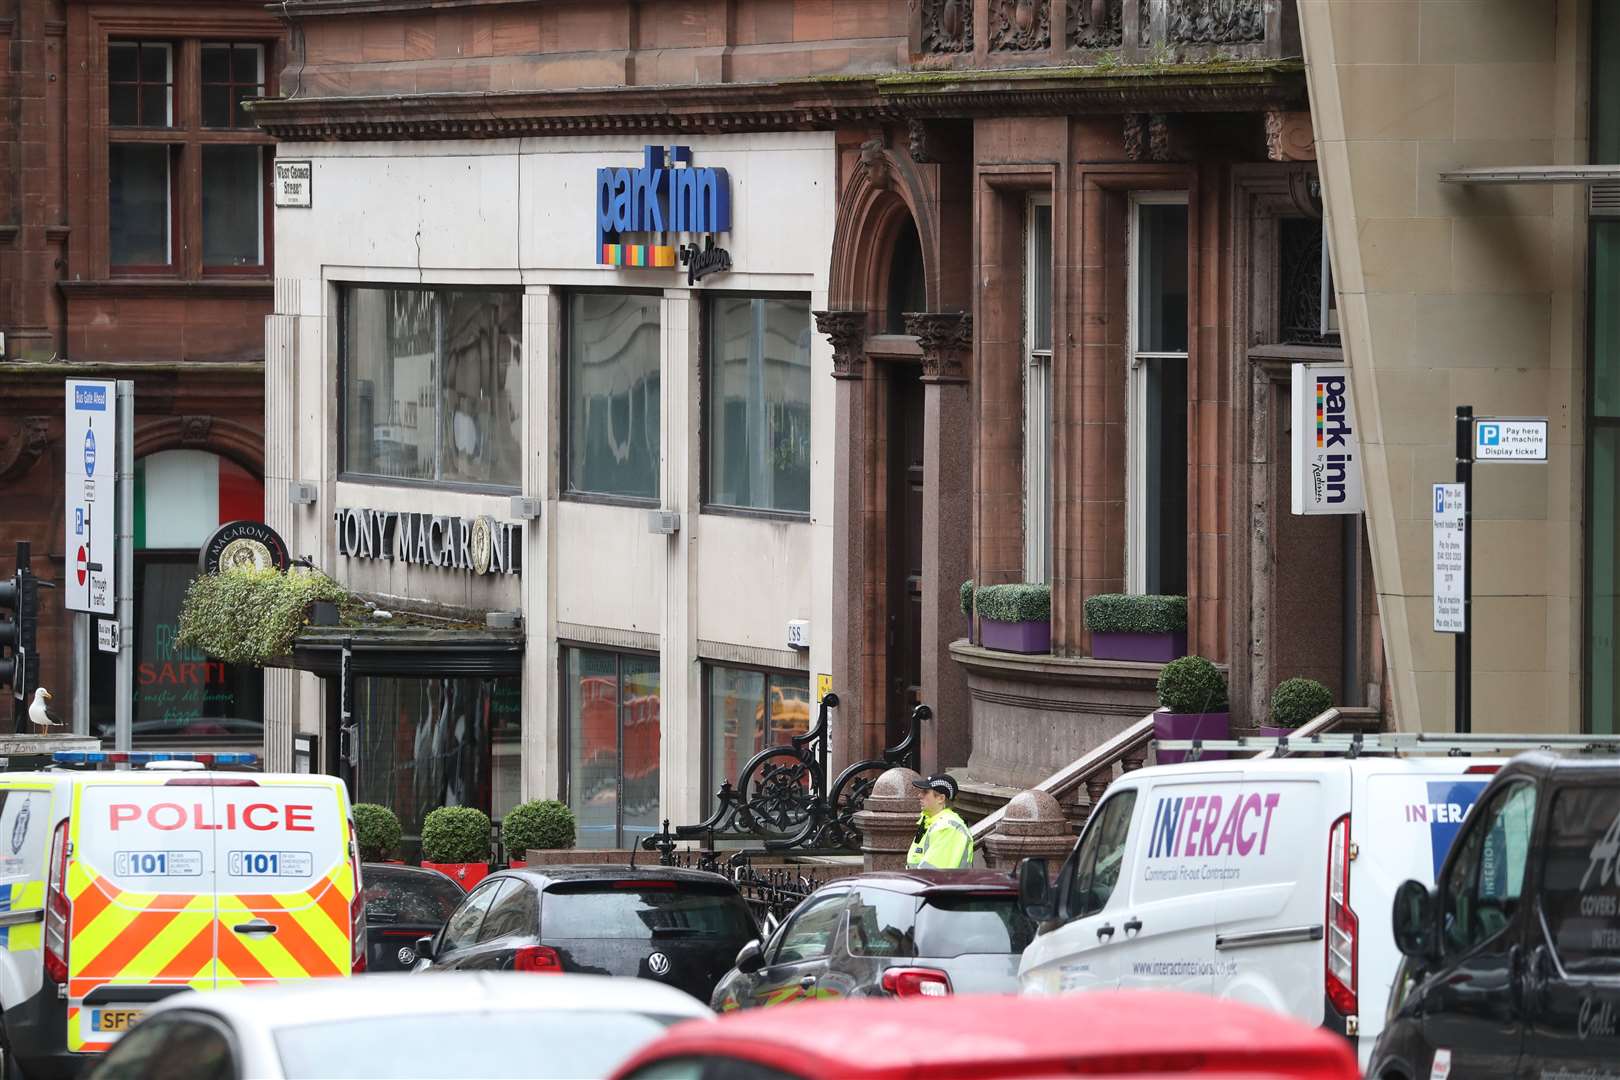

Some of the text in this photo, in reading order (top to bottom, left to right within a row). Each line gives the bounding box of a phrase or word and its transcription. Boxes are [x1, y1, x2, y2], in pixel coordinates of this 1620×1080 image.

[596, 144, 727, 264] park inn
[84, 391, 93, 405] Gate
[94, 391, 105, 405] Ahead
[1316, 376, 1352, 504] park inn
[1484, 426, 1496, 444] P
[1506, 427, 1520, 435] Pay
[1485, 448, 1513, 456] Display
[1312, 464, 1325, 504] Radisson
[334, 508, 394, 560] TONY
[398, 512, 520, 576] MACARONI
[138, 662, 225, 684] SARTI
[110, 802, 314, 831] POLICE
[1148, 792, 1280, 858] INTERACT
[131, 854, 165, 874] 101
[244, 854, 277, 874] 101
[1144, 864, 1240, 881] Commercial Fit-out Contractors
[1580, 896, 1616, 916] COVERS
